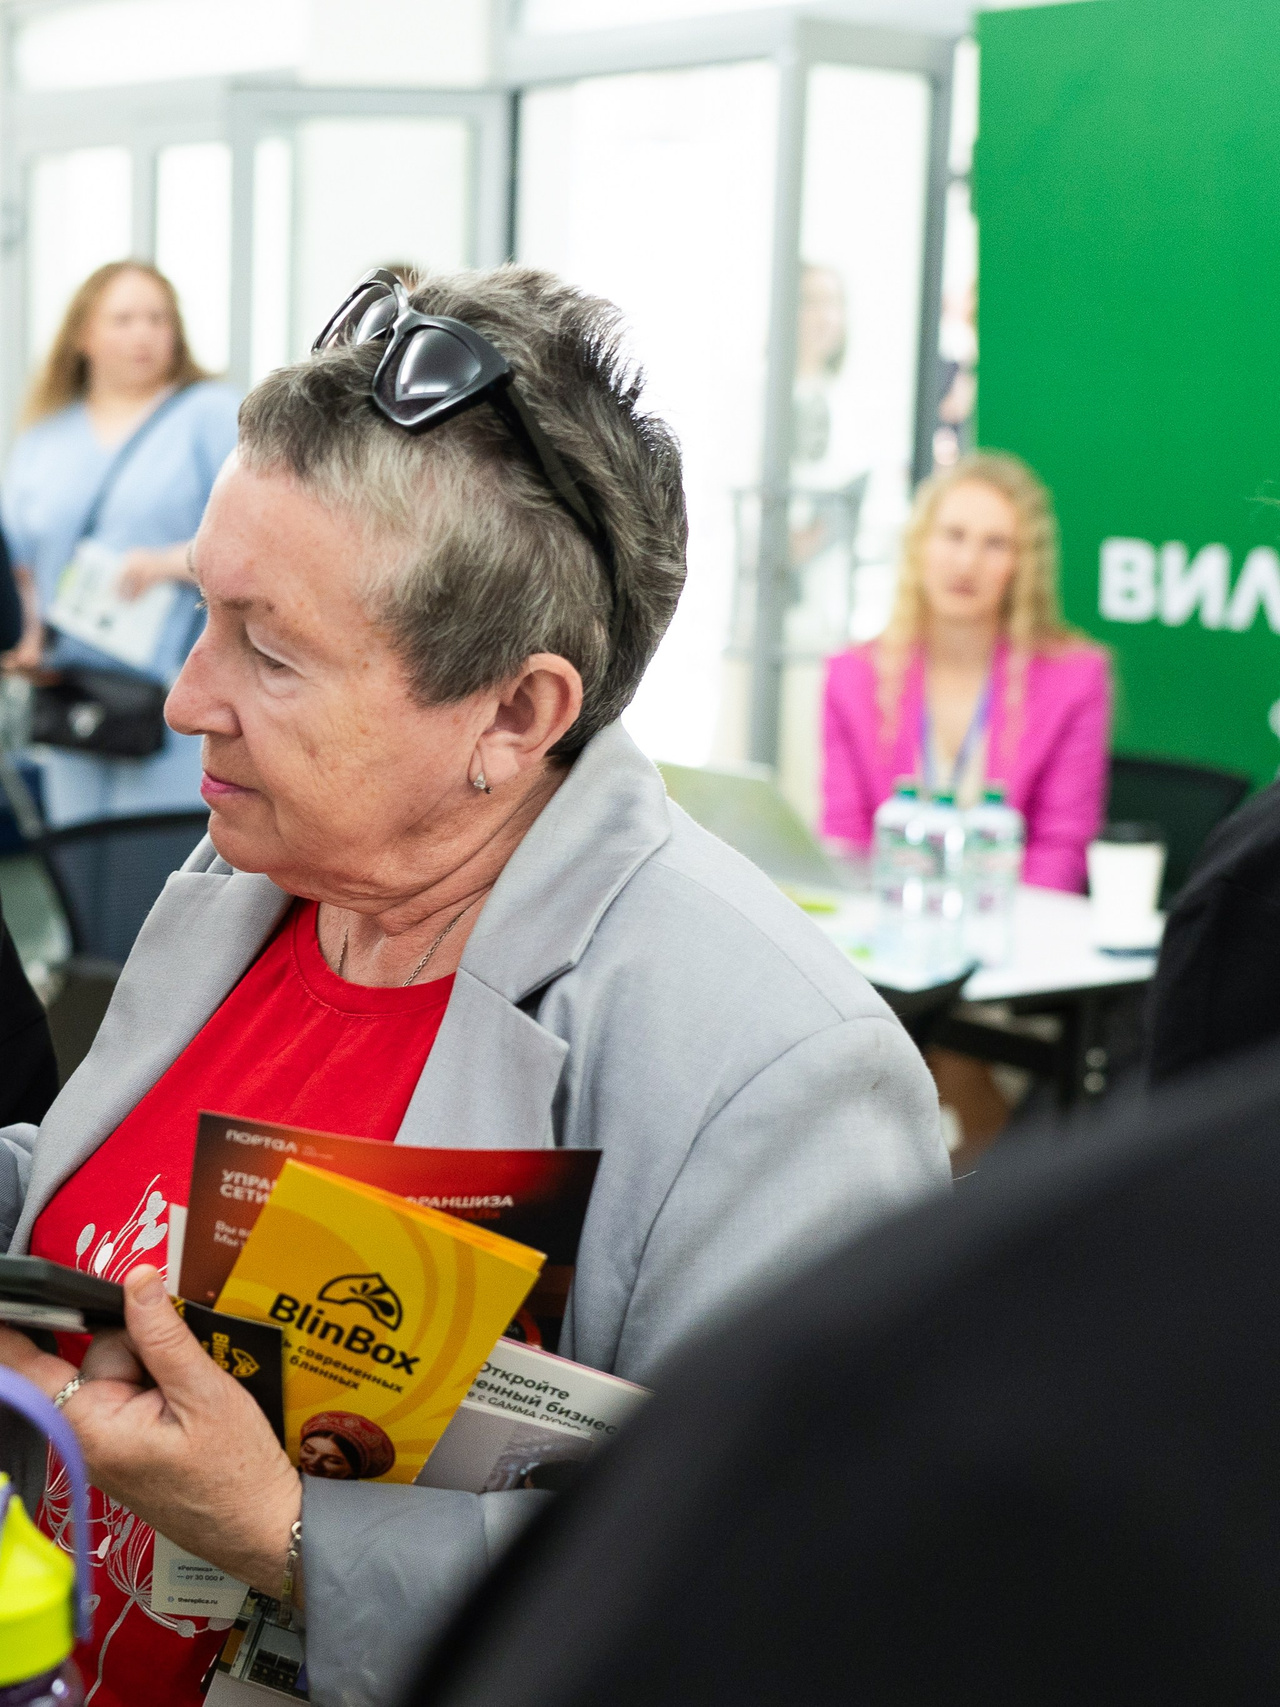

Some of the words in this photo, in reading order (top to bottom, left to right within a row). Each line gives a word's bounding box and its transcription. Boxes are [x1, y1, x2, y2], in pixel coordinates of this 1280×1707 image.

[222, 1169, 277, 1190] УПРА
[269, 1293, 421, 1375] BlinBox
[289, 1356, 360, 1390] блинных
[297, 1344, 404, 1394] современных
[480, 1361, 570, 1400] Откройте
[473, 1378, 542, 1408] енный
[545, 1401, 618, 1435] бизнес
[488, 1397, 536, 1419] GAMMA
